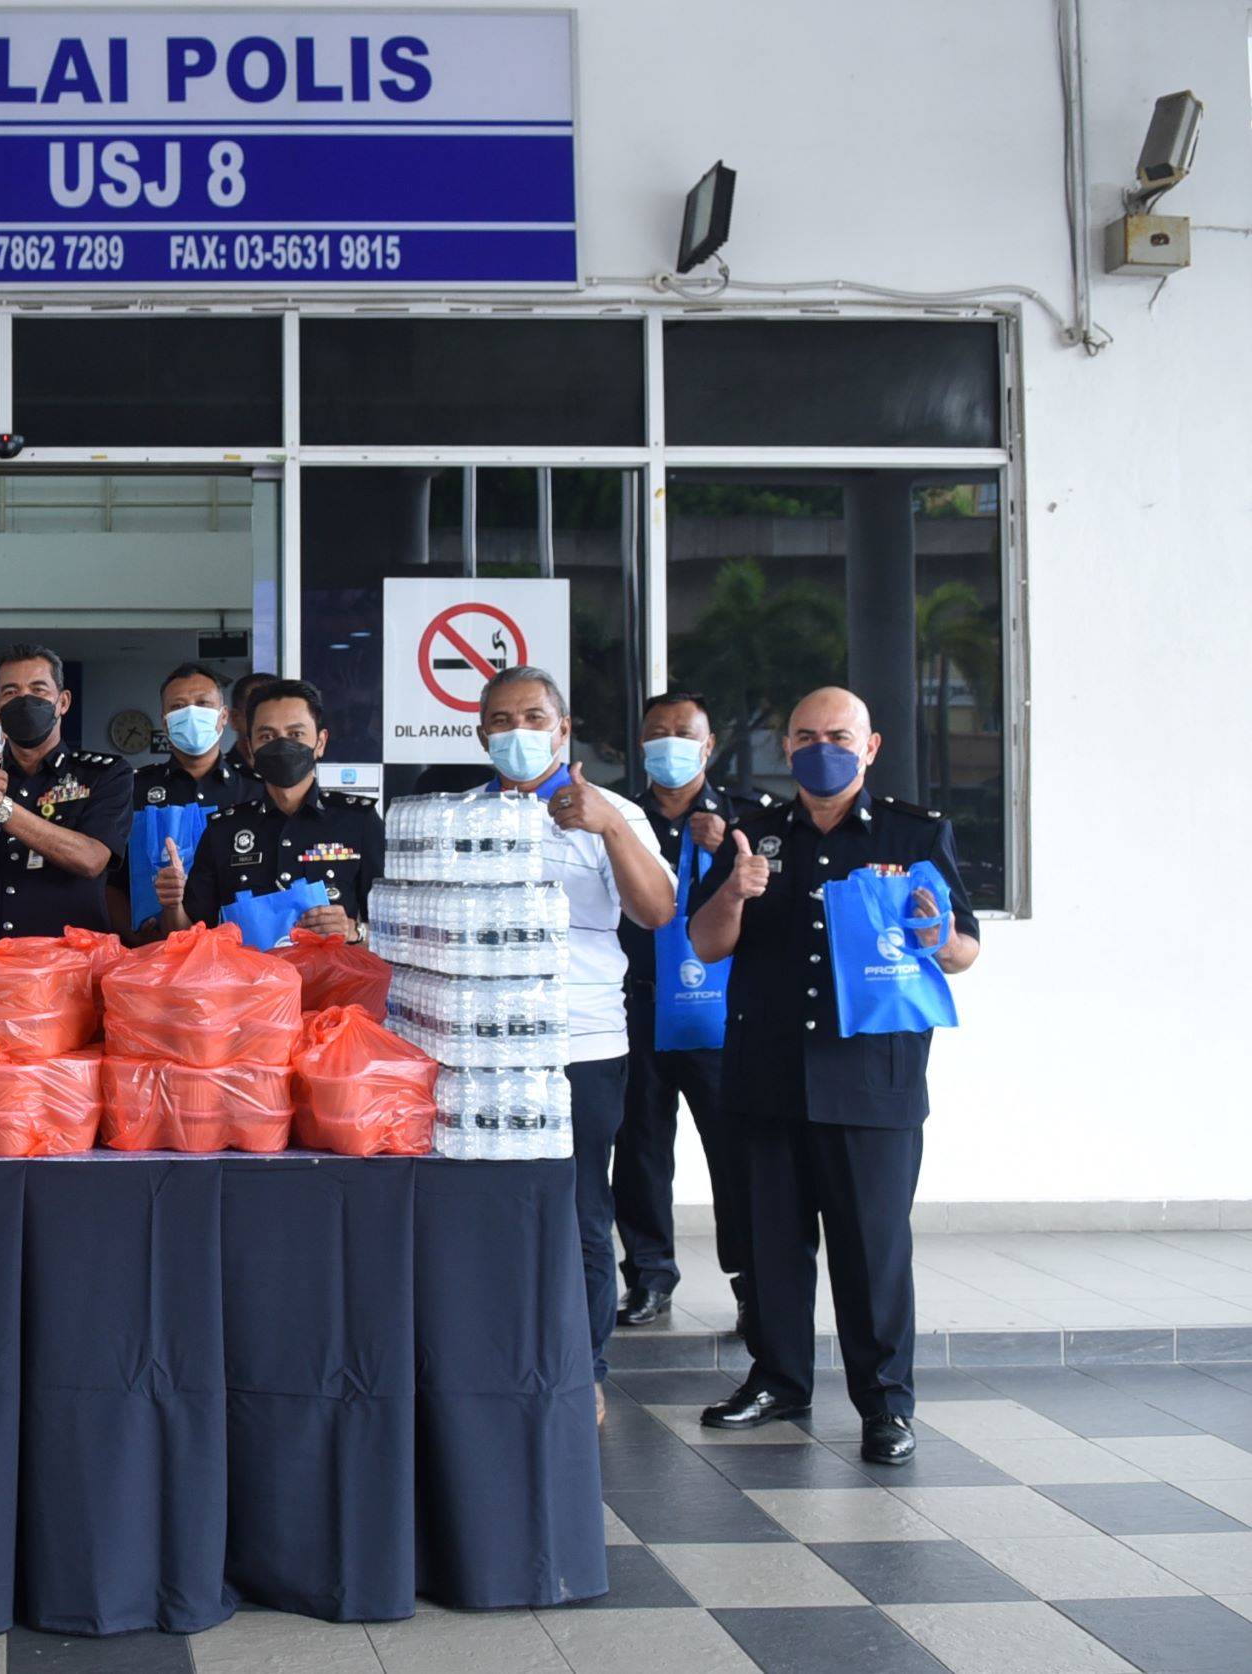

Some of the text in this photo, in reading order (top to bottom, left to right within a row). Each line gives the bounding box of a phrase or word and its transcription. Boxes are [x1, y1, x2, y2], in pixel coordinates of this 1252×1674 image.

[166, 36, 432, 104] POLIS
[49, 141, 246, 207] USJ 8
[63, 235, 124, 270] 7289
[170, 235, 401, 270] FAX: 03-5631 9815
[394, 724, 473, 738] DILARANG
[864, 964, 920, 975] PROTON
